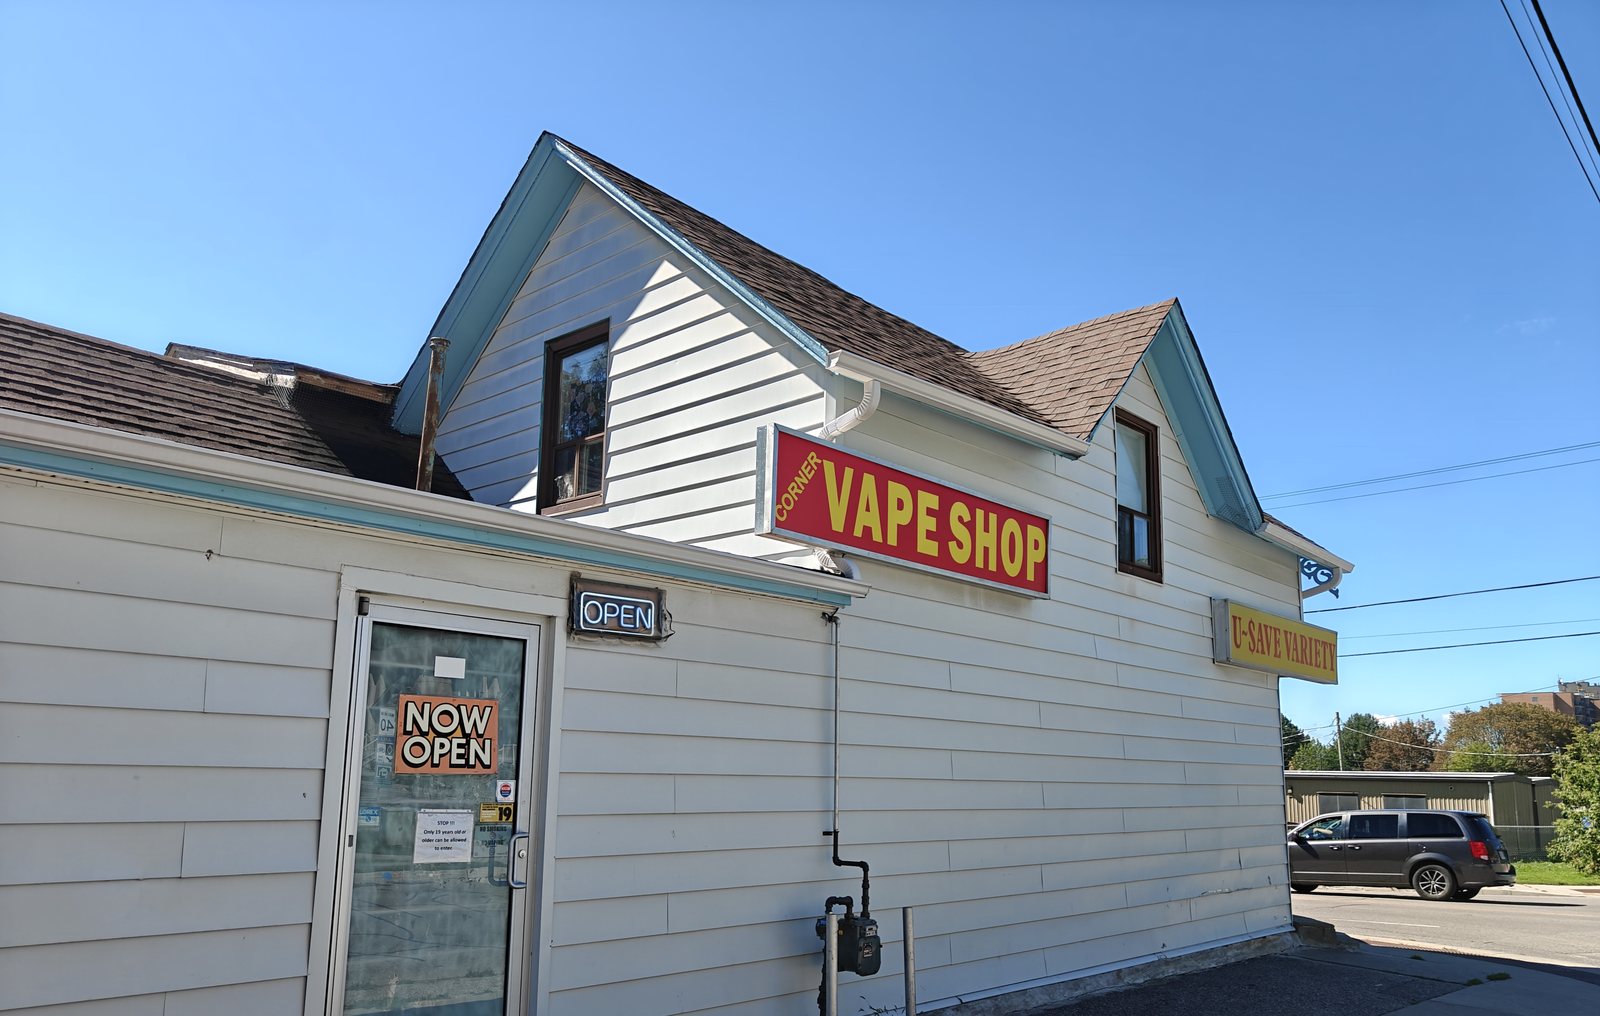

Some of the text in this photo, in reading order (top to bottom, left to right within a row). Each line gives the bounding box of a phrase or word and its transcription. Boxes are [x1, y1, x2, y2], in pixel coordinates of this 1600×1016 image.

[776, 451, 822, 522] CORNER
[823, 459, 1046, 582] VAPE SHOP
[584, 600, 651, 629] OPEN
[1283, 629, 1336, 672] VARIETY
[403, 701, 493, 738] NOW
[402, 735, 492, 769] OPEN
[498, 806, 512, 821] 19
